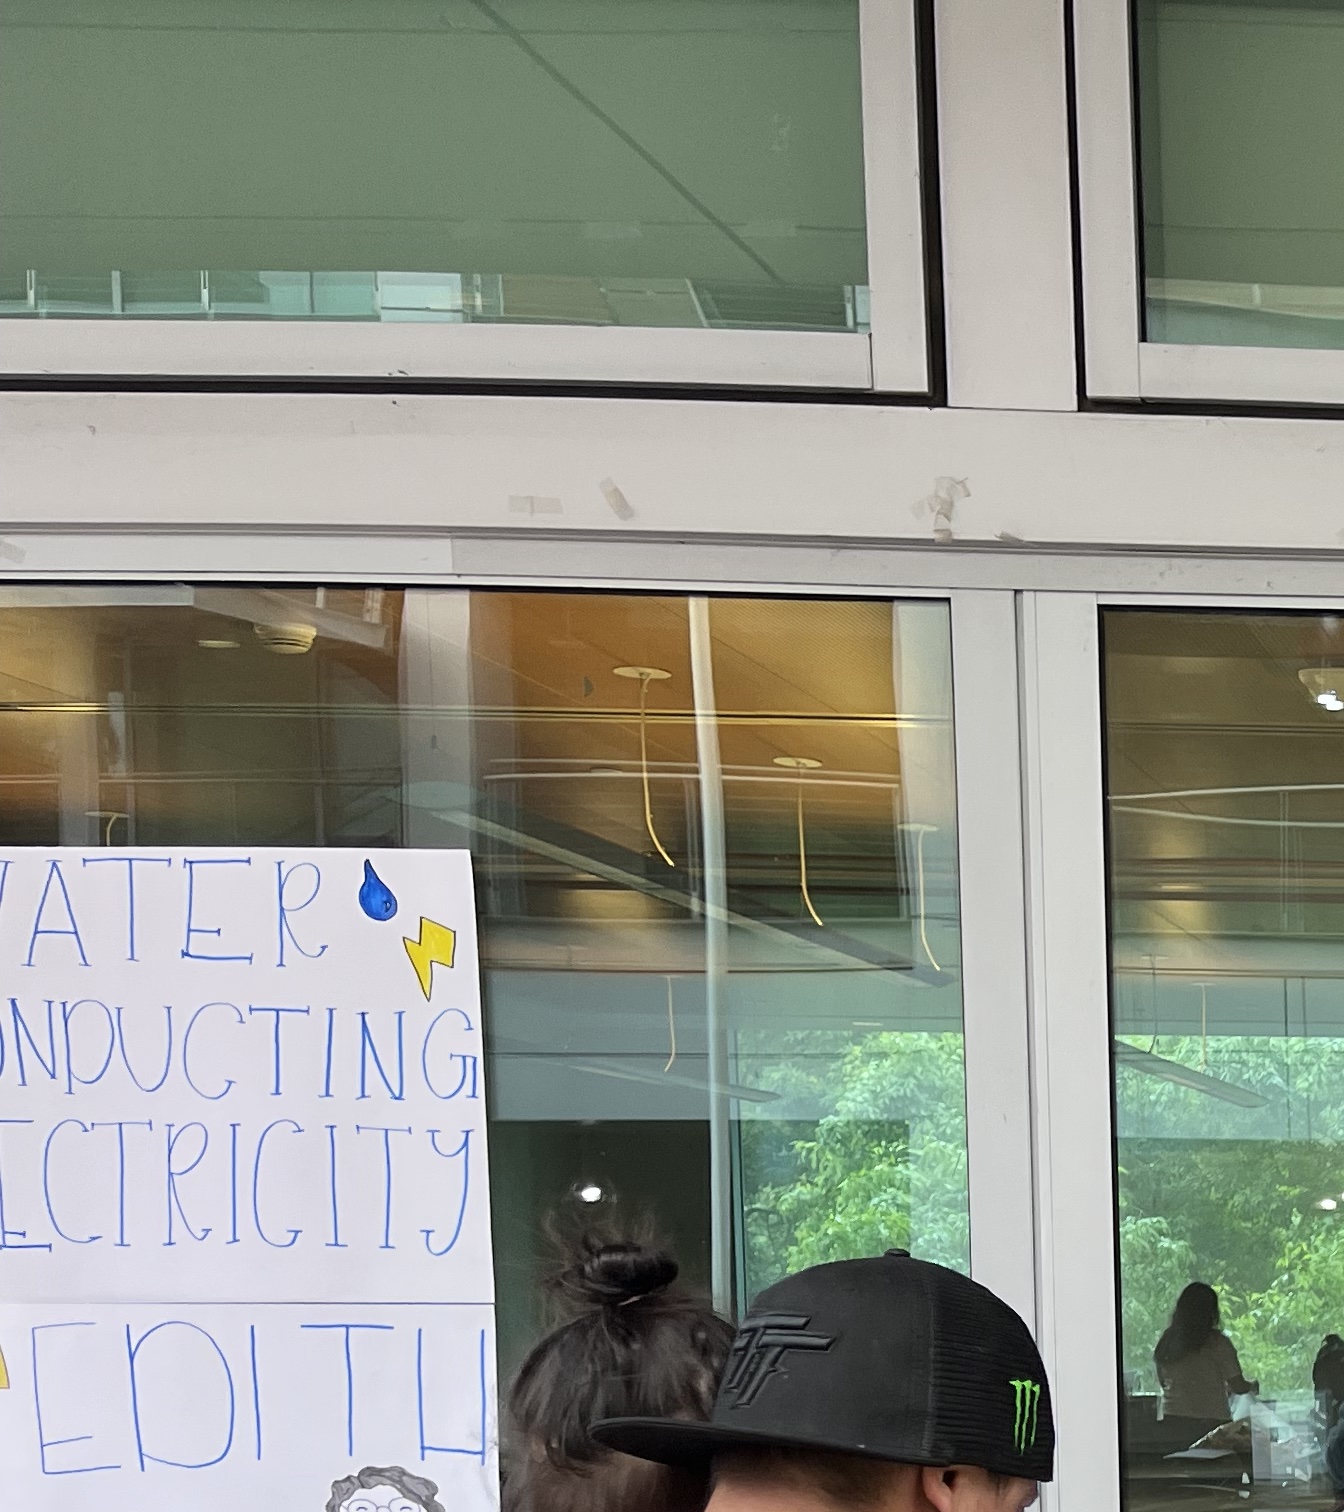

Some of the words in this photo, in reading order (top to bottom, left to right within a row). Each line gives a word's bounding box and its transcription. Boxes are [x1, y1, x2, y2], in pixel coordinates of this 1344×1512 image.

[0, 858, 328, 967] ATER
[0, 997, 479, 1101] NDUCTING
[31, 1320, 487, 1476] EDITH
